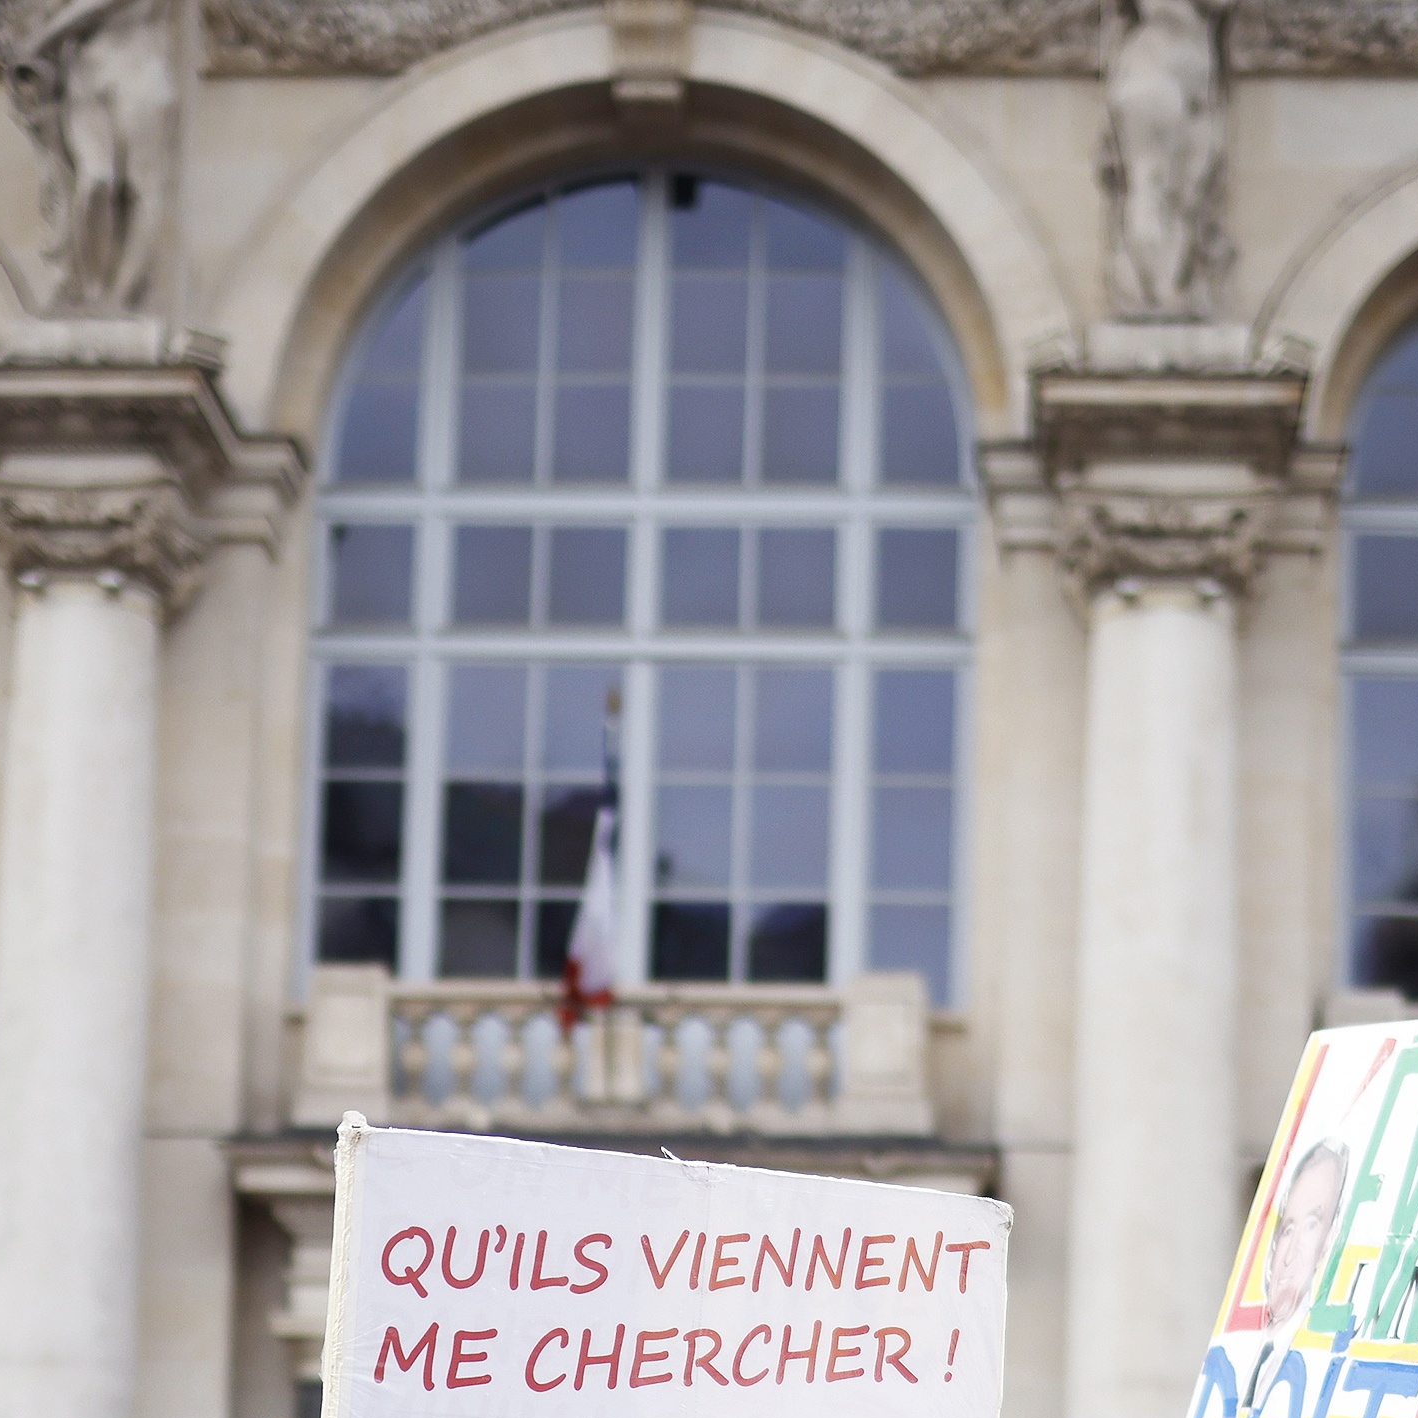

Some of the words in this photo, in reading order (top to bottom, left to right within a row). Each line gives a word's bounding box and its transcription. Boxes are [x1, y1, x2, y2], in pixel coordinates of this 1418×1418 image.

[381, 1223, 613, 1299] QU'ILS
[640, 1226, 991, 1294] VIENNENT
[372, 1321, 497, 1392] ME
[524, 1320, 919, 1393] CHERCHER
[943, 1328, 961, 1383] !
